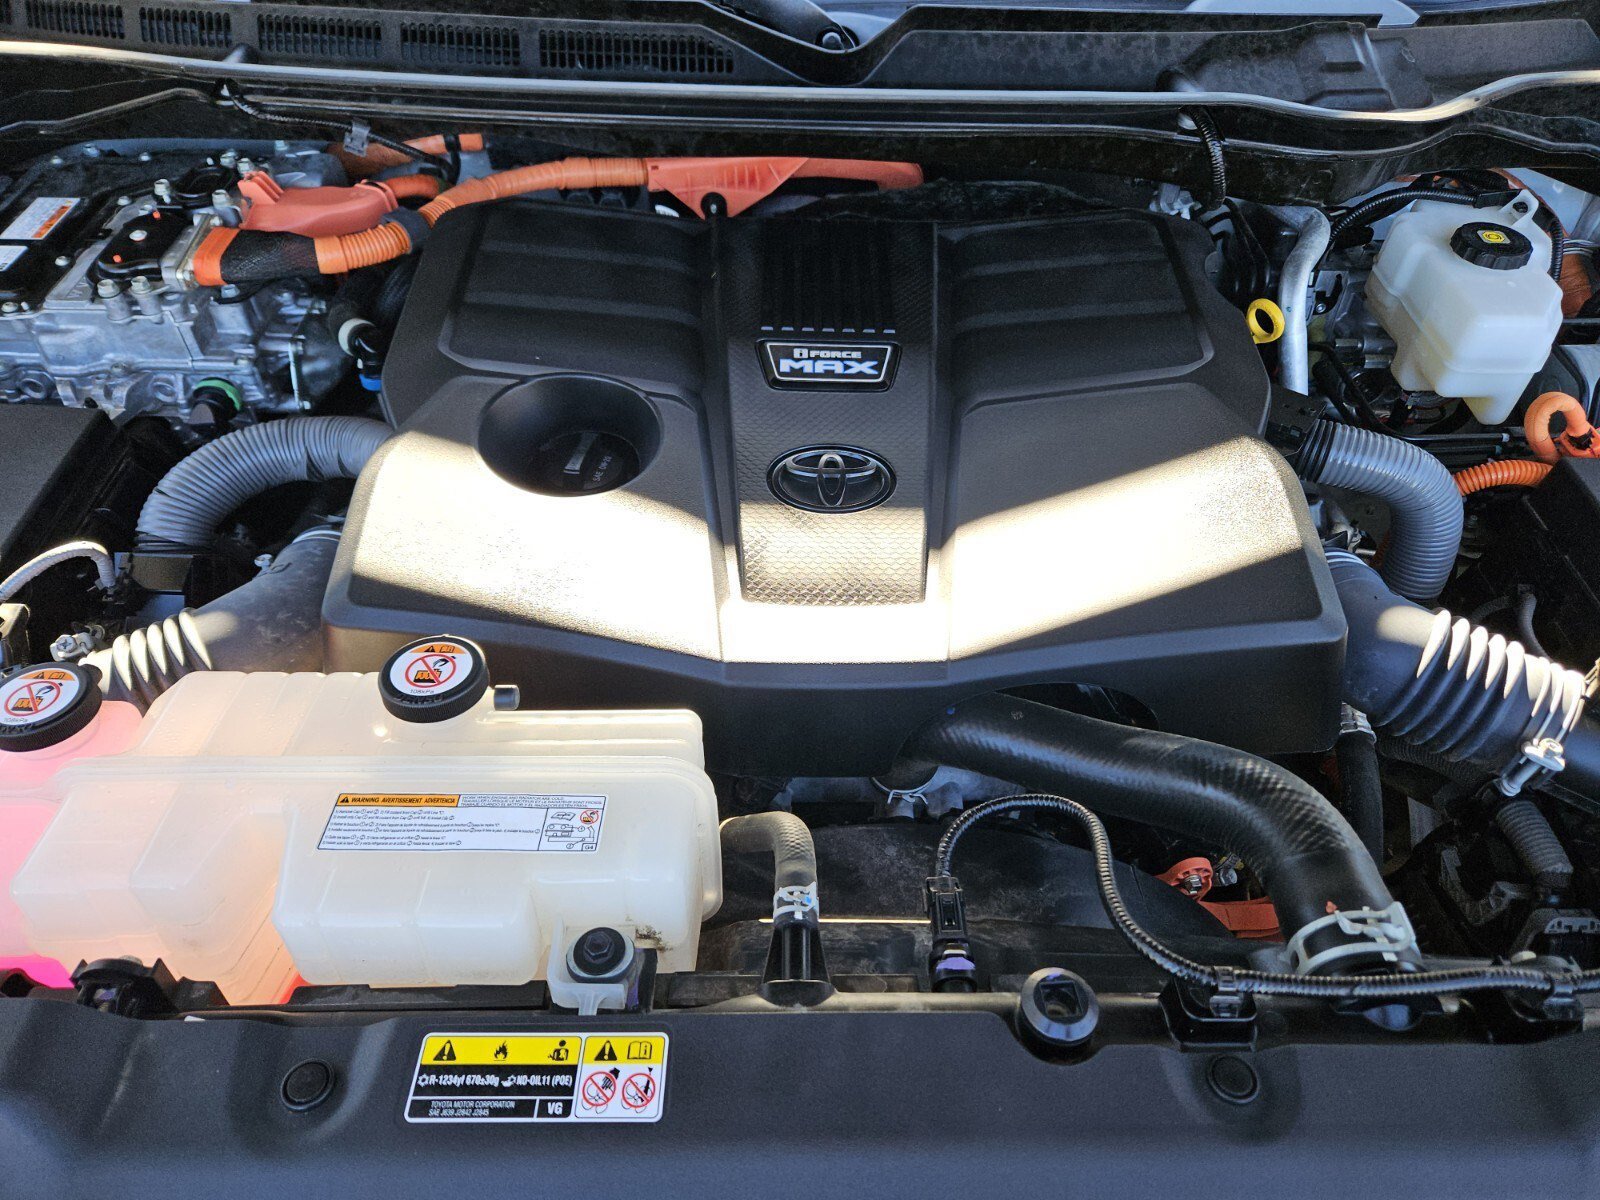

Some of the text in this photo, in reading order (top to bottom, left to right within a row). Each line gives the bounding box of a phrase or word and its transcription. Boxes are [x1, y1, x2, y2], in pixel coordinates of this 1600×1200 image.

[779, 358, 879, 375] MAX
[351, 796, 456, 804] WARNING AVERTISSEMENT ADVERTENCIA
[551, 1075, 573, 1088] (POE)
[430, 1101, 516, 1109] TOYOTA MOTOR CORPORATION
[547, 1101, 564, 1115] VG
